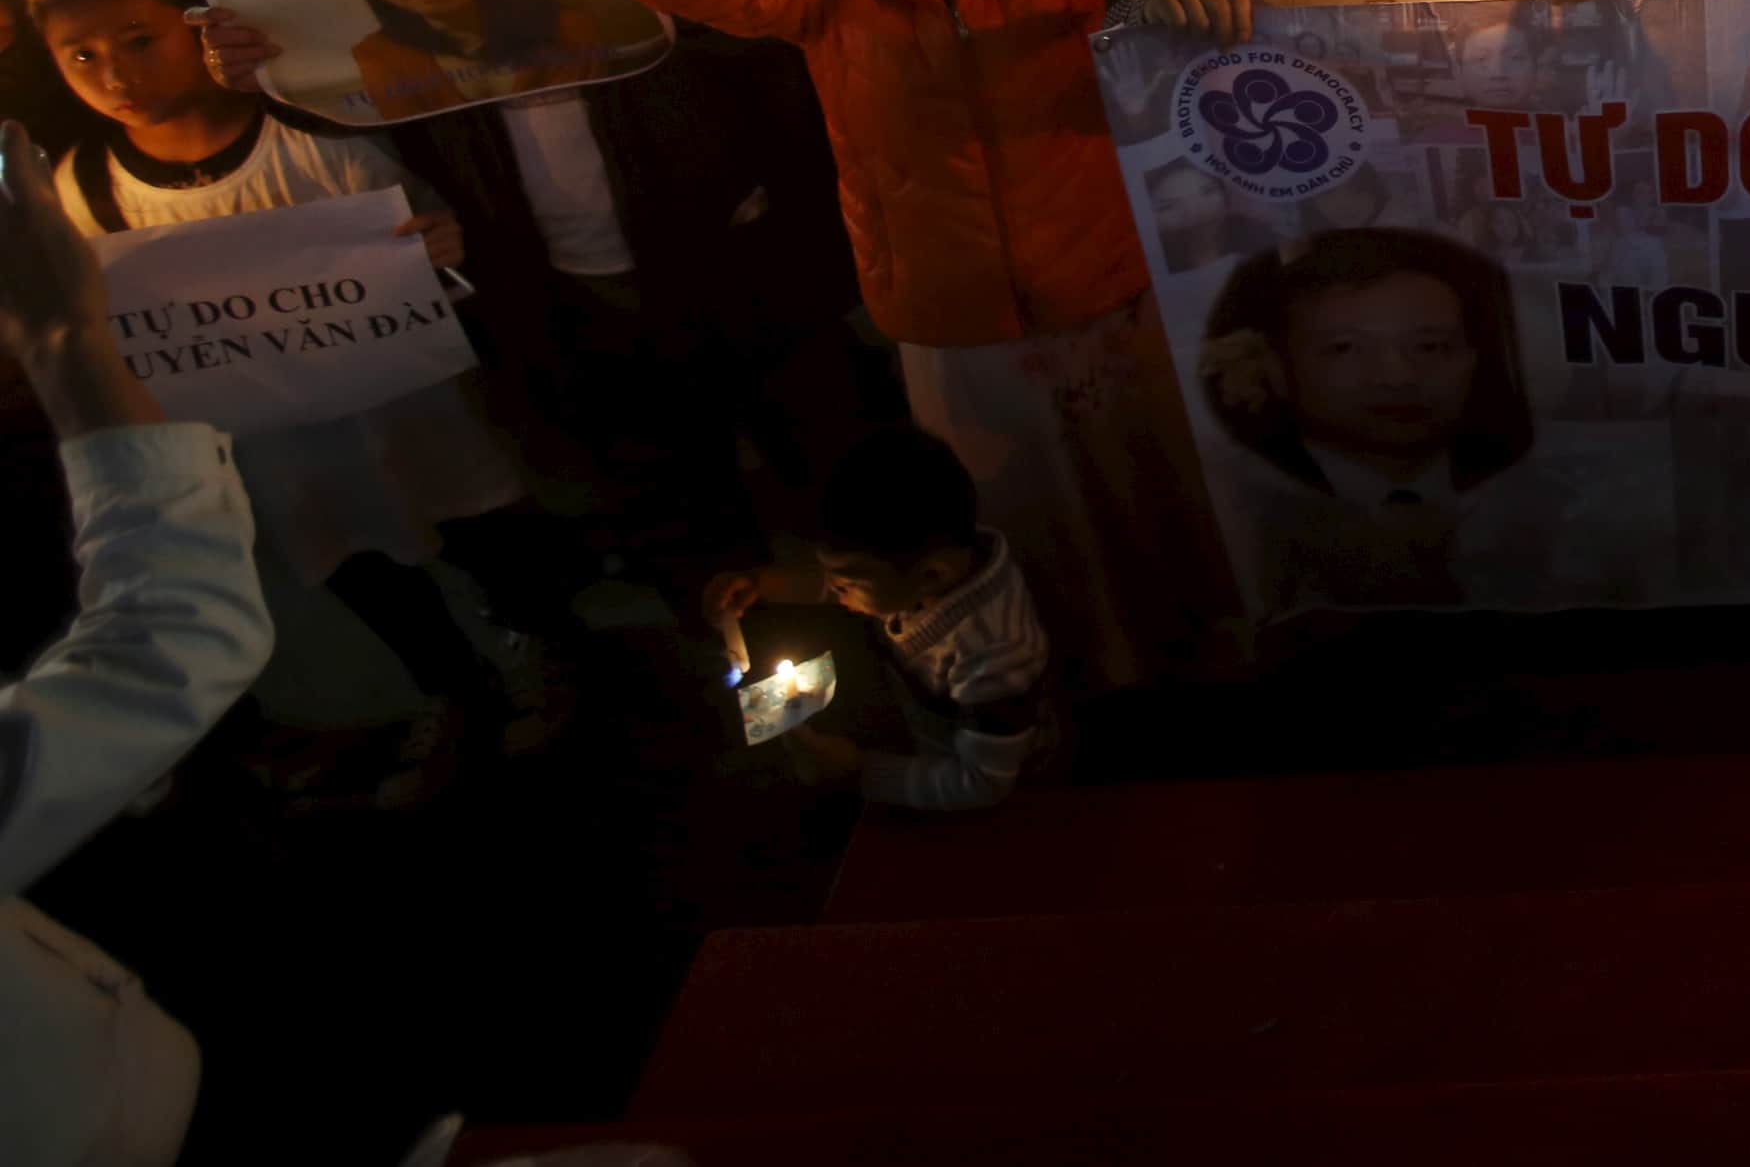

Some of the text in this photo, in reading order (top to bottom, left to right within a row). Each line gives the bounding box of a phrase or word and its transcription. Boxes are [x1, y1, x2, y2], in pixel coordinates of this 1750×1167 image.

[1177, 52, 1365, 138] BROTHERHOOD FOR DEMOCRACY
[1231, 175, 1265, 195] ANH
[1269, 187, 1294, 197] EM
[1465, 101, 1628, 219] TỰ
[110, 278, 366, 339] TỰ DO CHO
[124, 300, 447, 380] UYỄN VĂN ĐÀI
